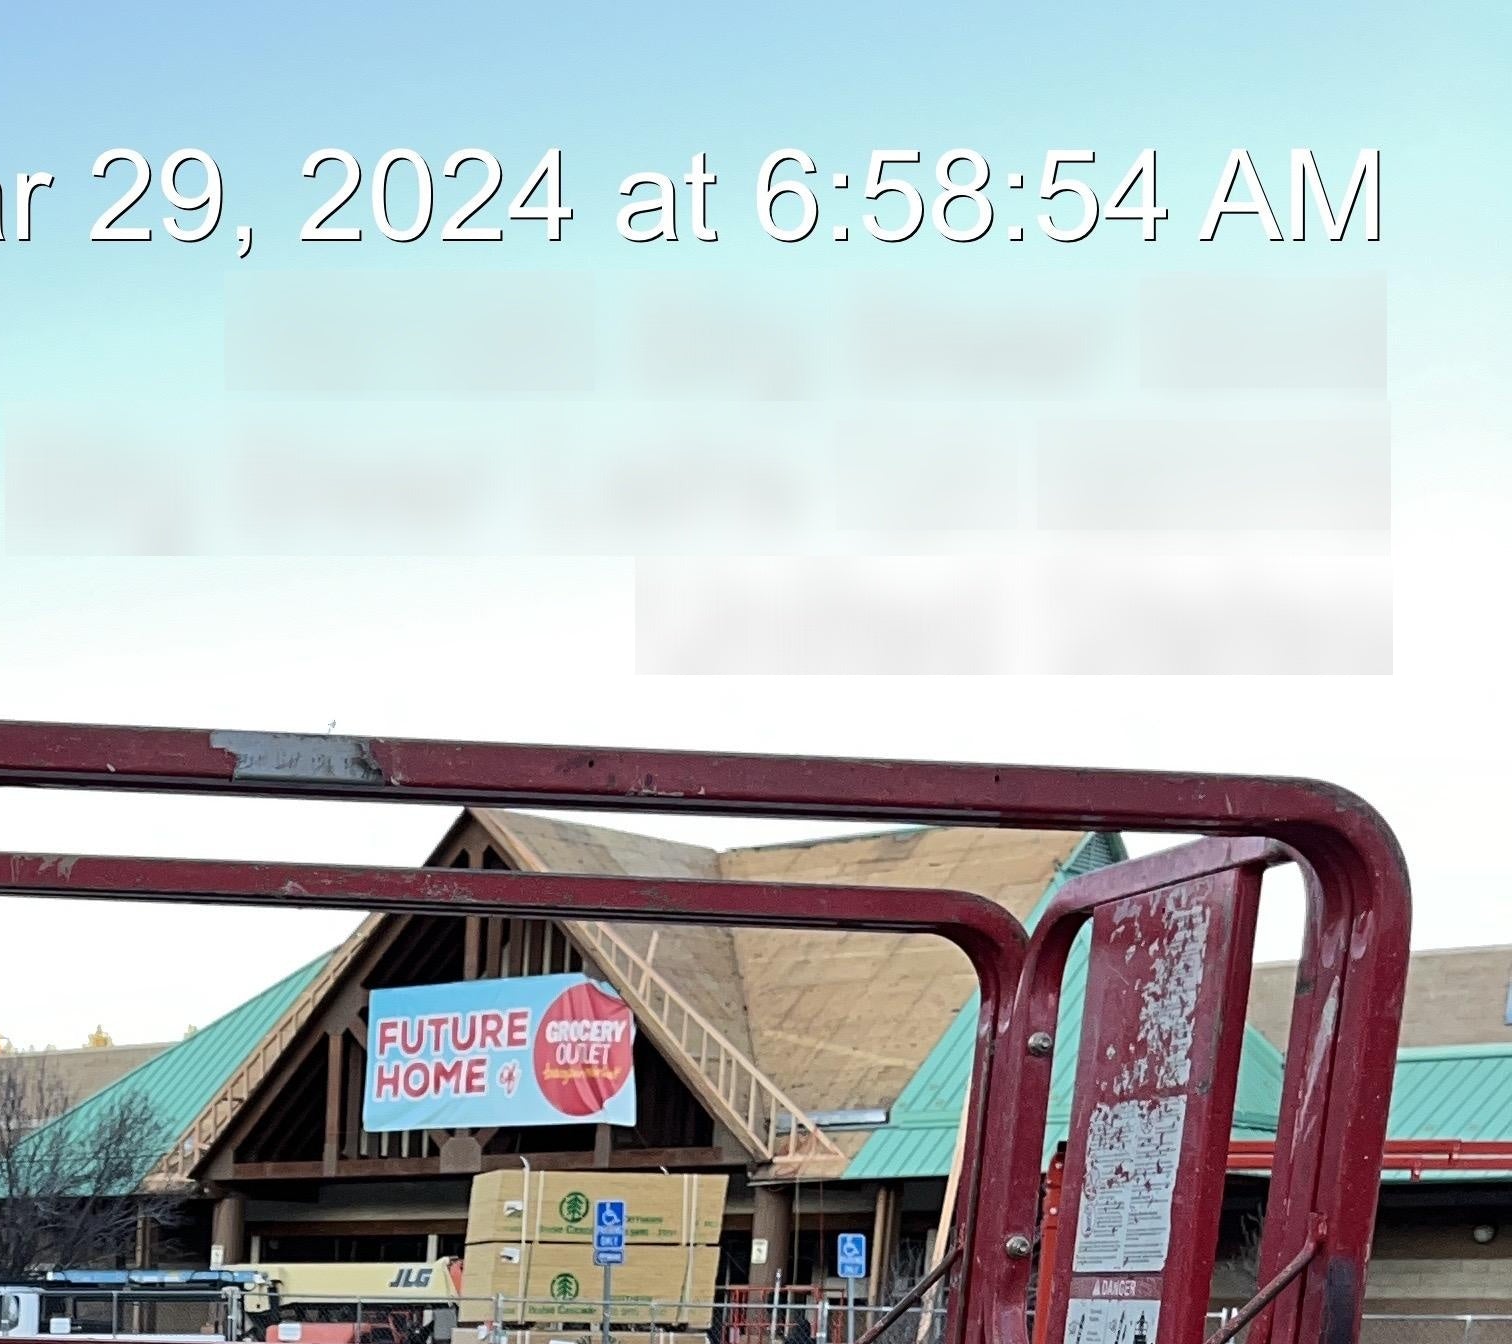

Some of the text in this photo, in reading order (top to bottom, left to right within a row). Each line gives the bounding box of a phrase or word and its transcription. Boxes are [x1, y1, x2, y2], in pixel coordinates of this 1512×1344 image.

[378, 1010, 529, 1057] FUTURE
[545, 1018, 628, 1044] GROCERY
[375, 1057, 520, 1099] HOME of
[389, 1268, 433, 1288] JLG
[1101, 1281, 1137, 1297] DANGER
